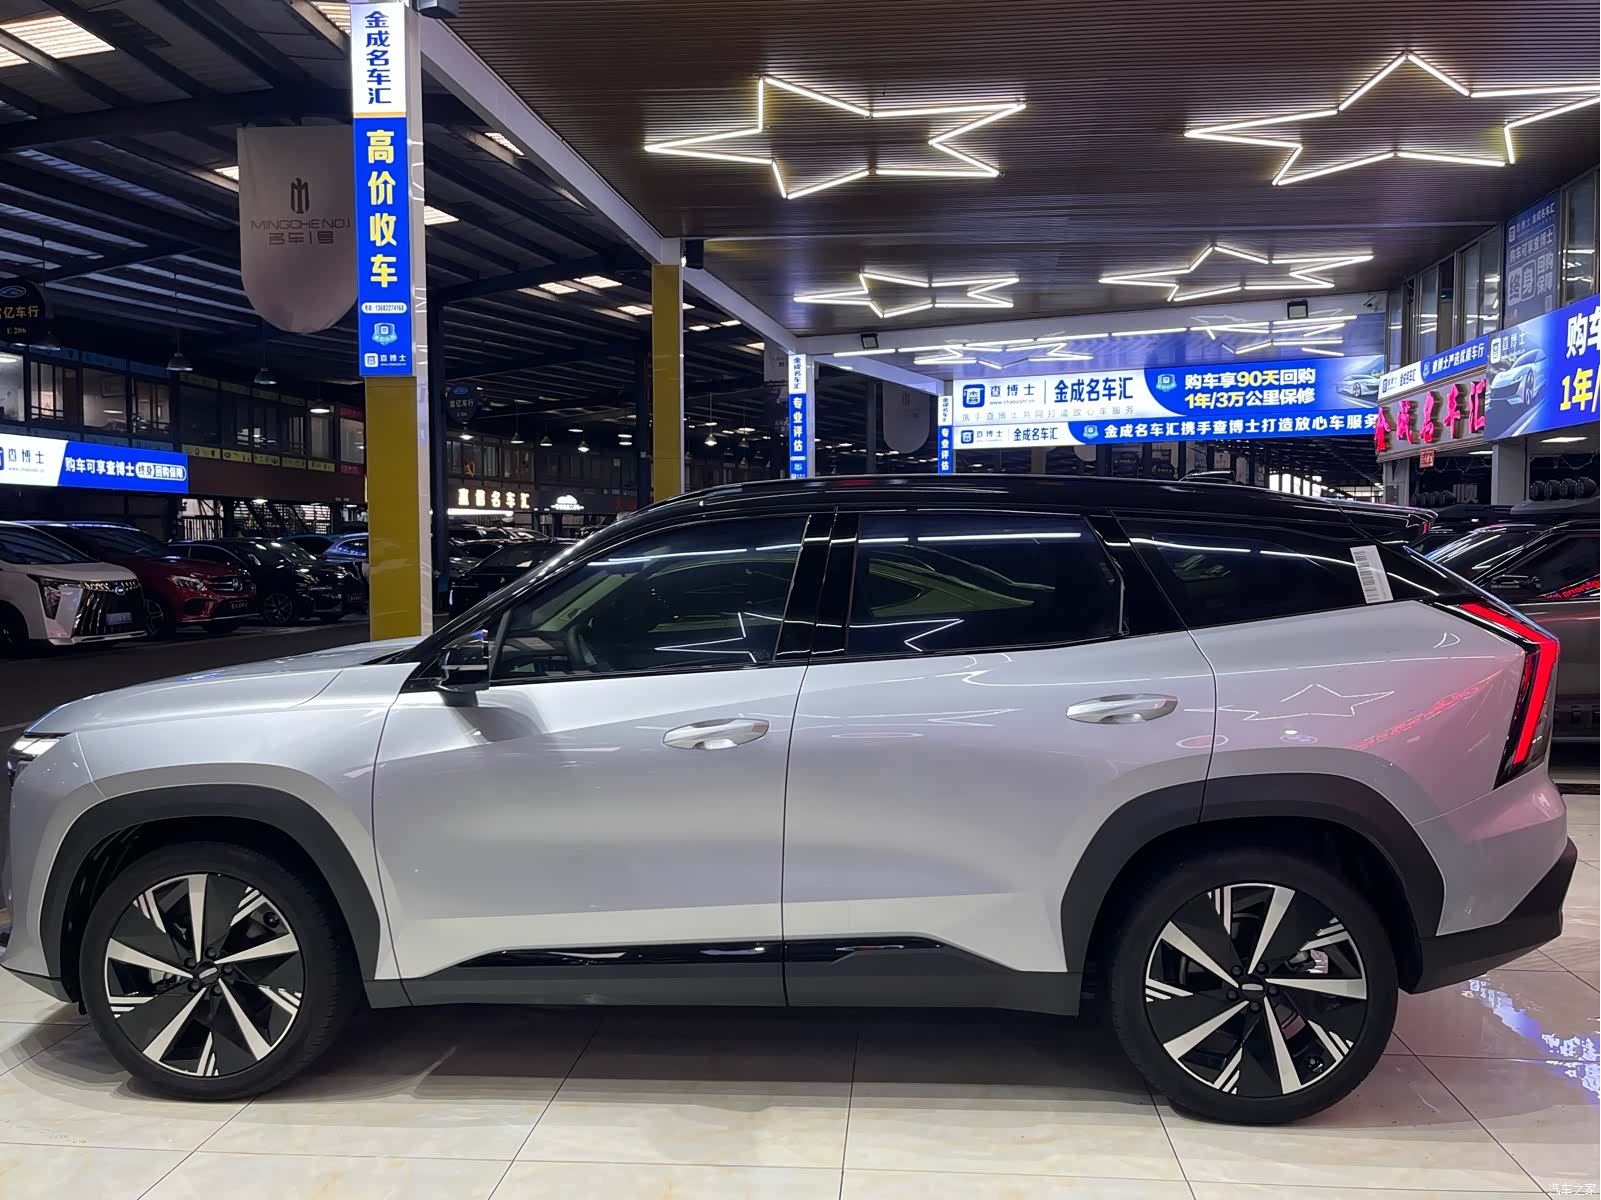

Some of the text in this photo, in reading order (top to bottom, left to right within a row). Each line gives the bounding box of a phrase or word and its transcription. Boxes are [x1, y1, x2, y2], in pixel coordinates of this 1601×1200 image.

[365, 10, 391, 104] 金成名车汇
[366, 129, 397, 288] 高价收车
[250, 218, 321, 230] MINGCHE
[1509, 229, 1553, 263] 购车可享查博士
[0, 305, 39, 319] 亿车行
[990, 384, 1035, 398] 查博士
[1054, 376, 1134, 403] 金成名车汇
[1184, 368, 1316, 390] 购车享90天回购
[1184, 387, 1316, 409] 1年/3万公里保修
[793, 397, 803, 452] 专业评估
[1013, 427, 1059, 442] 金成名车汇
[8, 448, 44, 465] 查博士
